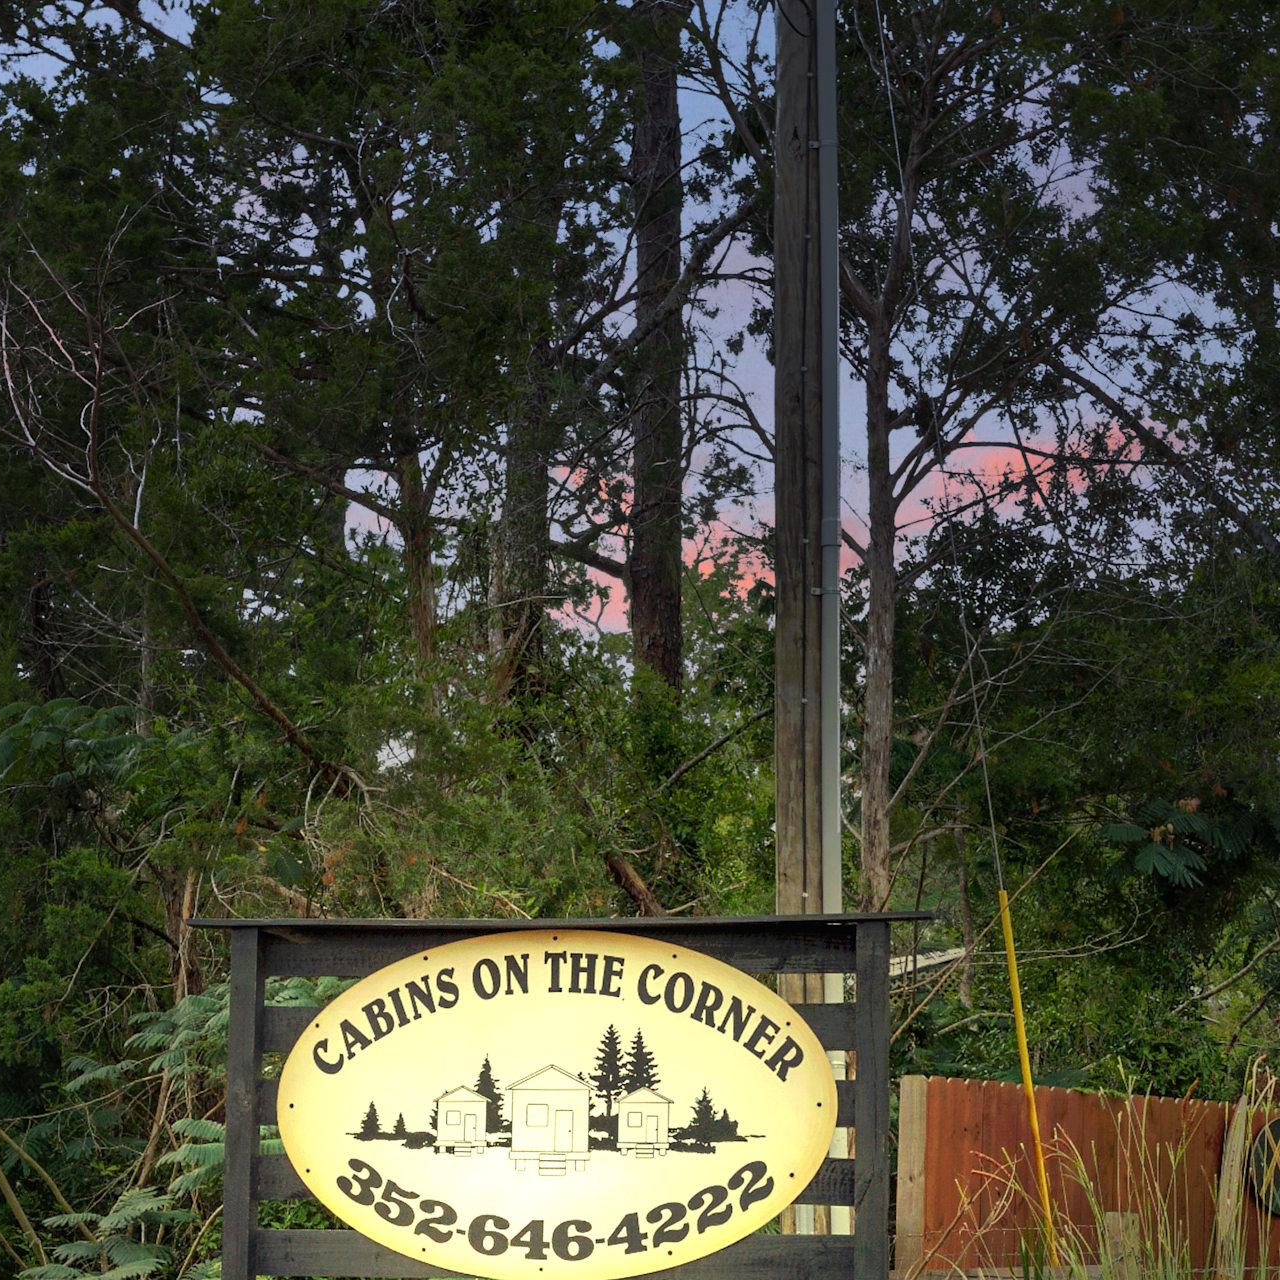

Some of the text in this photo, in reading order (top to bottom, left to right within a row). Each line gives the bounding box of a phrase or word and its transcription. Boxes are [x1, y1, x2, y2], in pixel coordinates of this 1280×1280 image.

[313, 950, 804, 1082] CABINS ON THE CORNER
[336, 1158, 775, 1261] 352-646-4222
